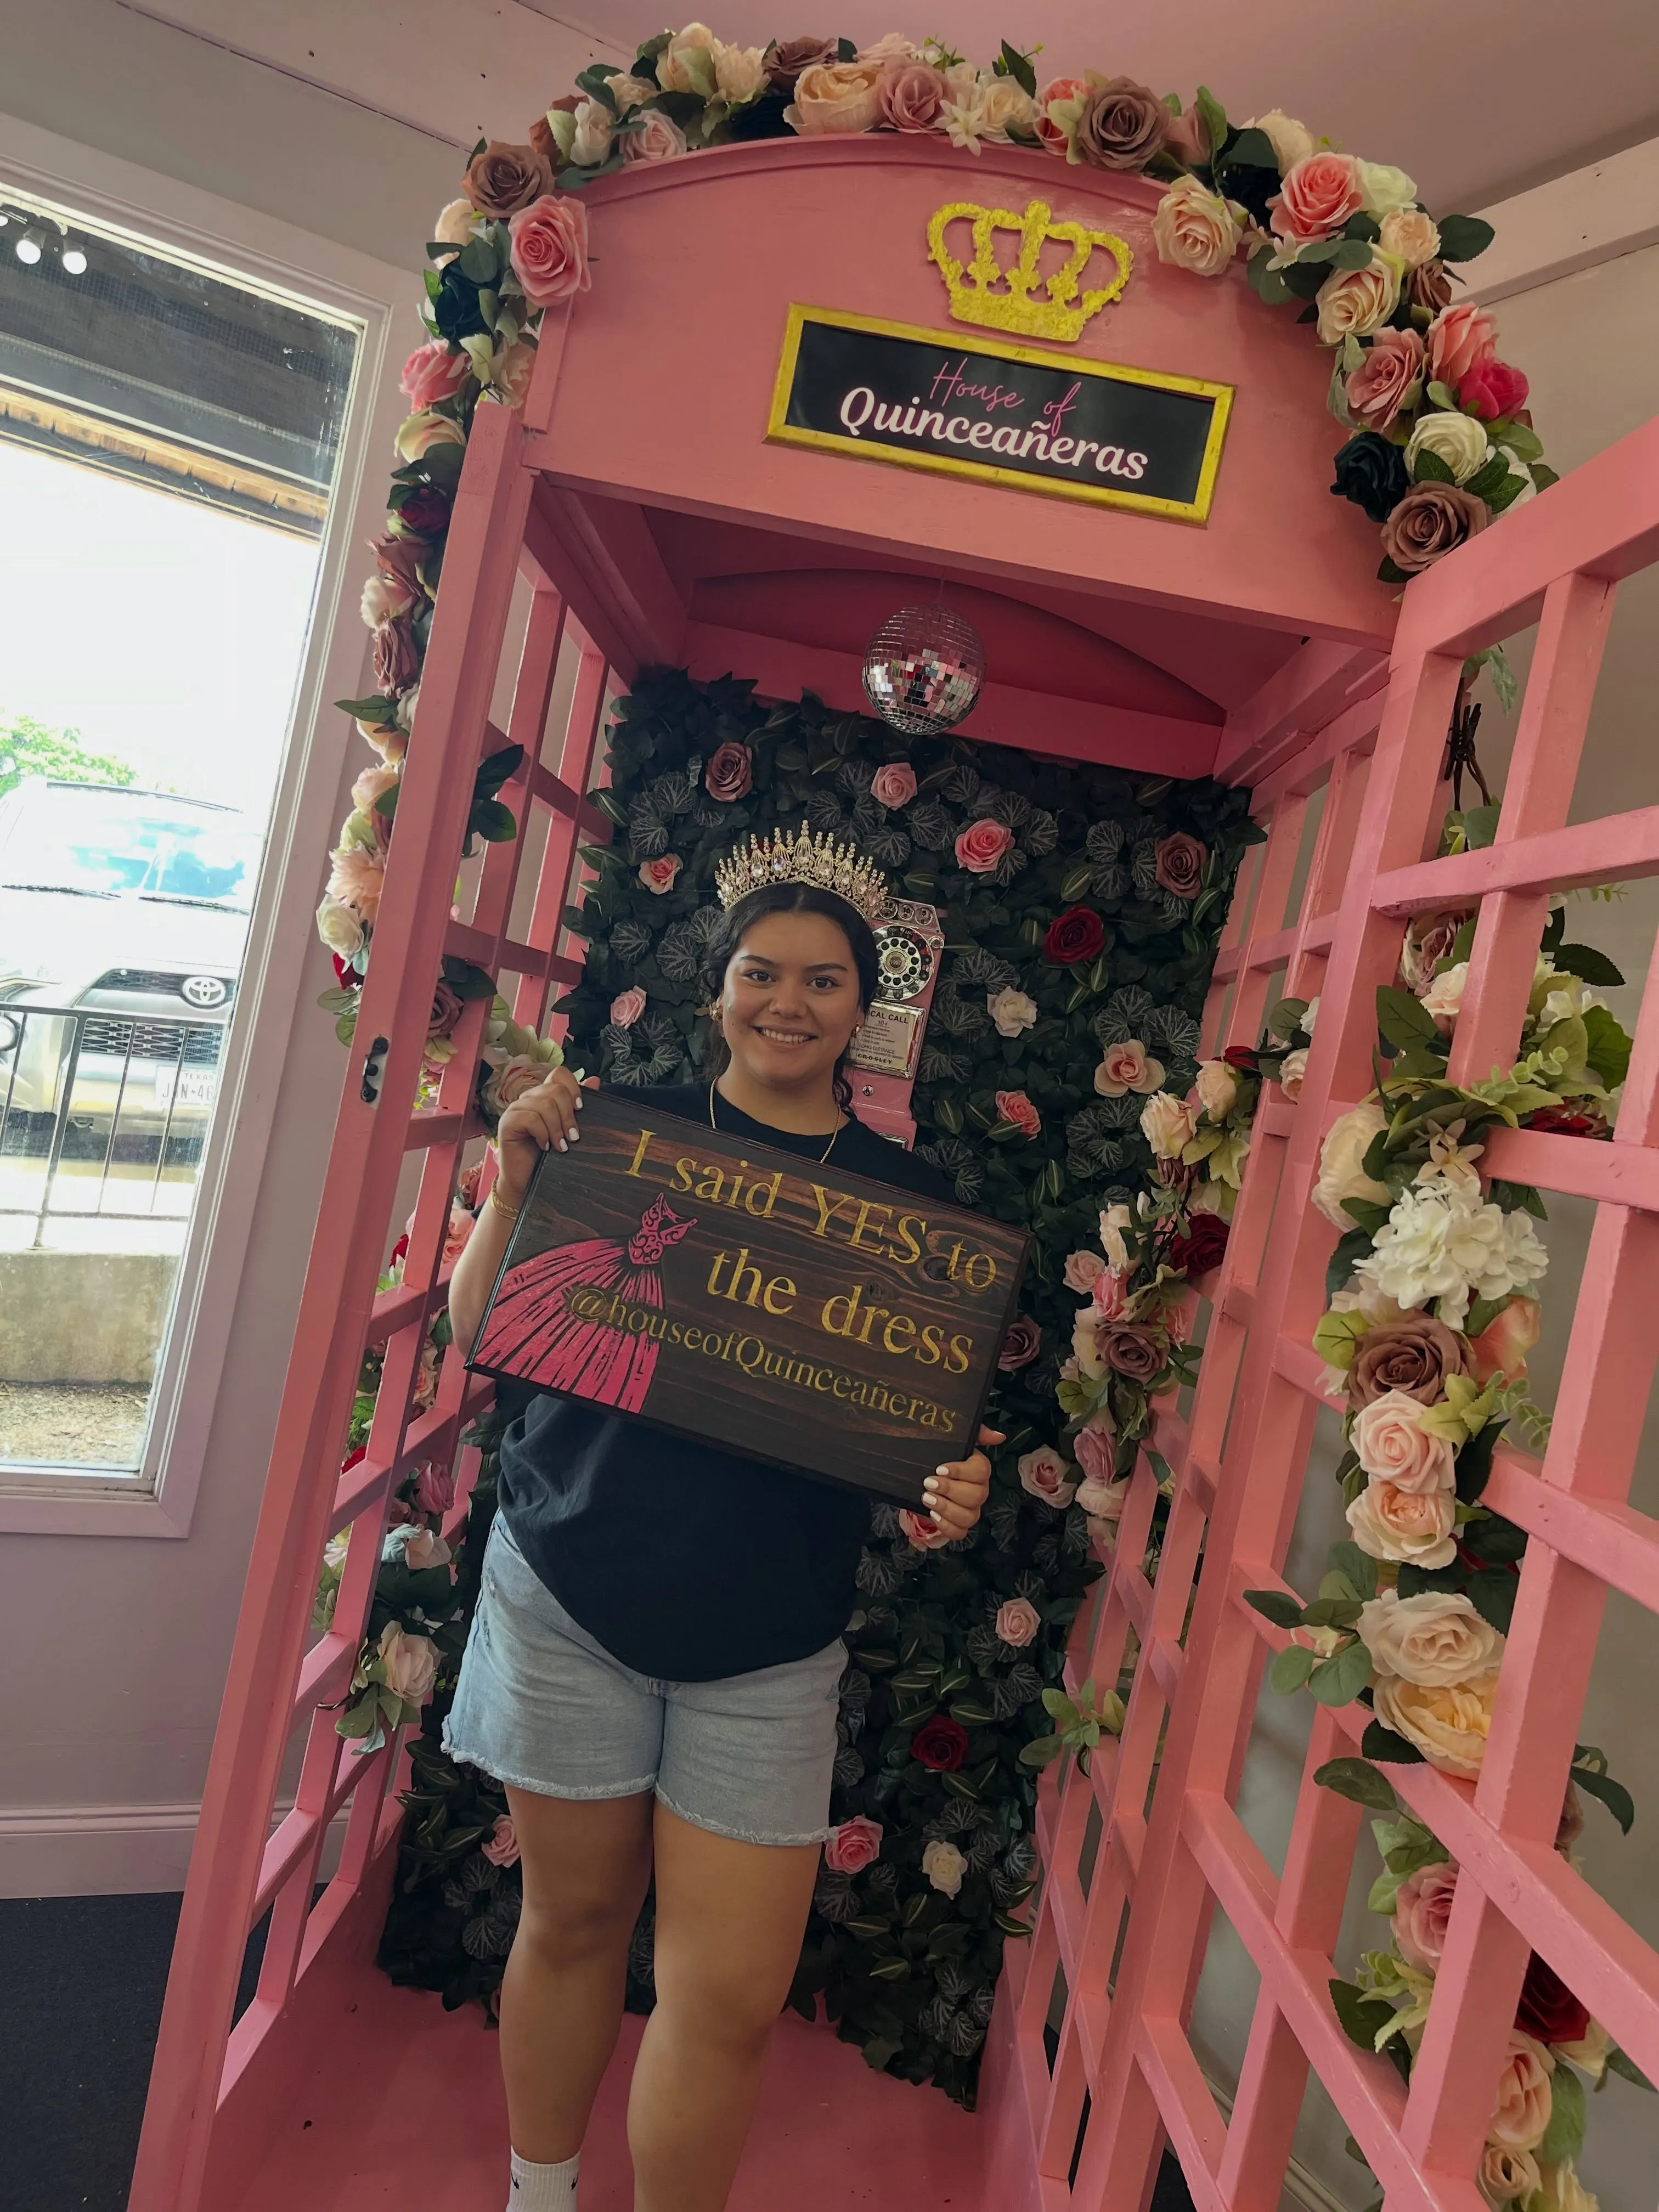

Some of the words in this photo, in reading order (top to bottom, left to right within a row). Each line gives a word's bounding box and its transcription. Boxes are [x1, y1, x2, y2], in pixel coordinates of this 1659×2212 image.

[840, 387, 1149, 480] Quinceañeras
[929, 358, 1025, 411] House
[1043, 382, 1082, 437] of
[888, 1014, 909, 1024] CALL
[184, 1073, 215, 1081] TEXAS
[624, 1128, 657, 1178] I
[668, 1158, 784, 1219] said
[810, 1183, 928, 1265] YES
[946, 1238, 997, 1289] to
[705, 1248, 799, 1316] the
[821, 1284, 974, 1374] dress
[569, 1287, 957, 1434] @houseofQuinceañeras
